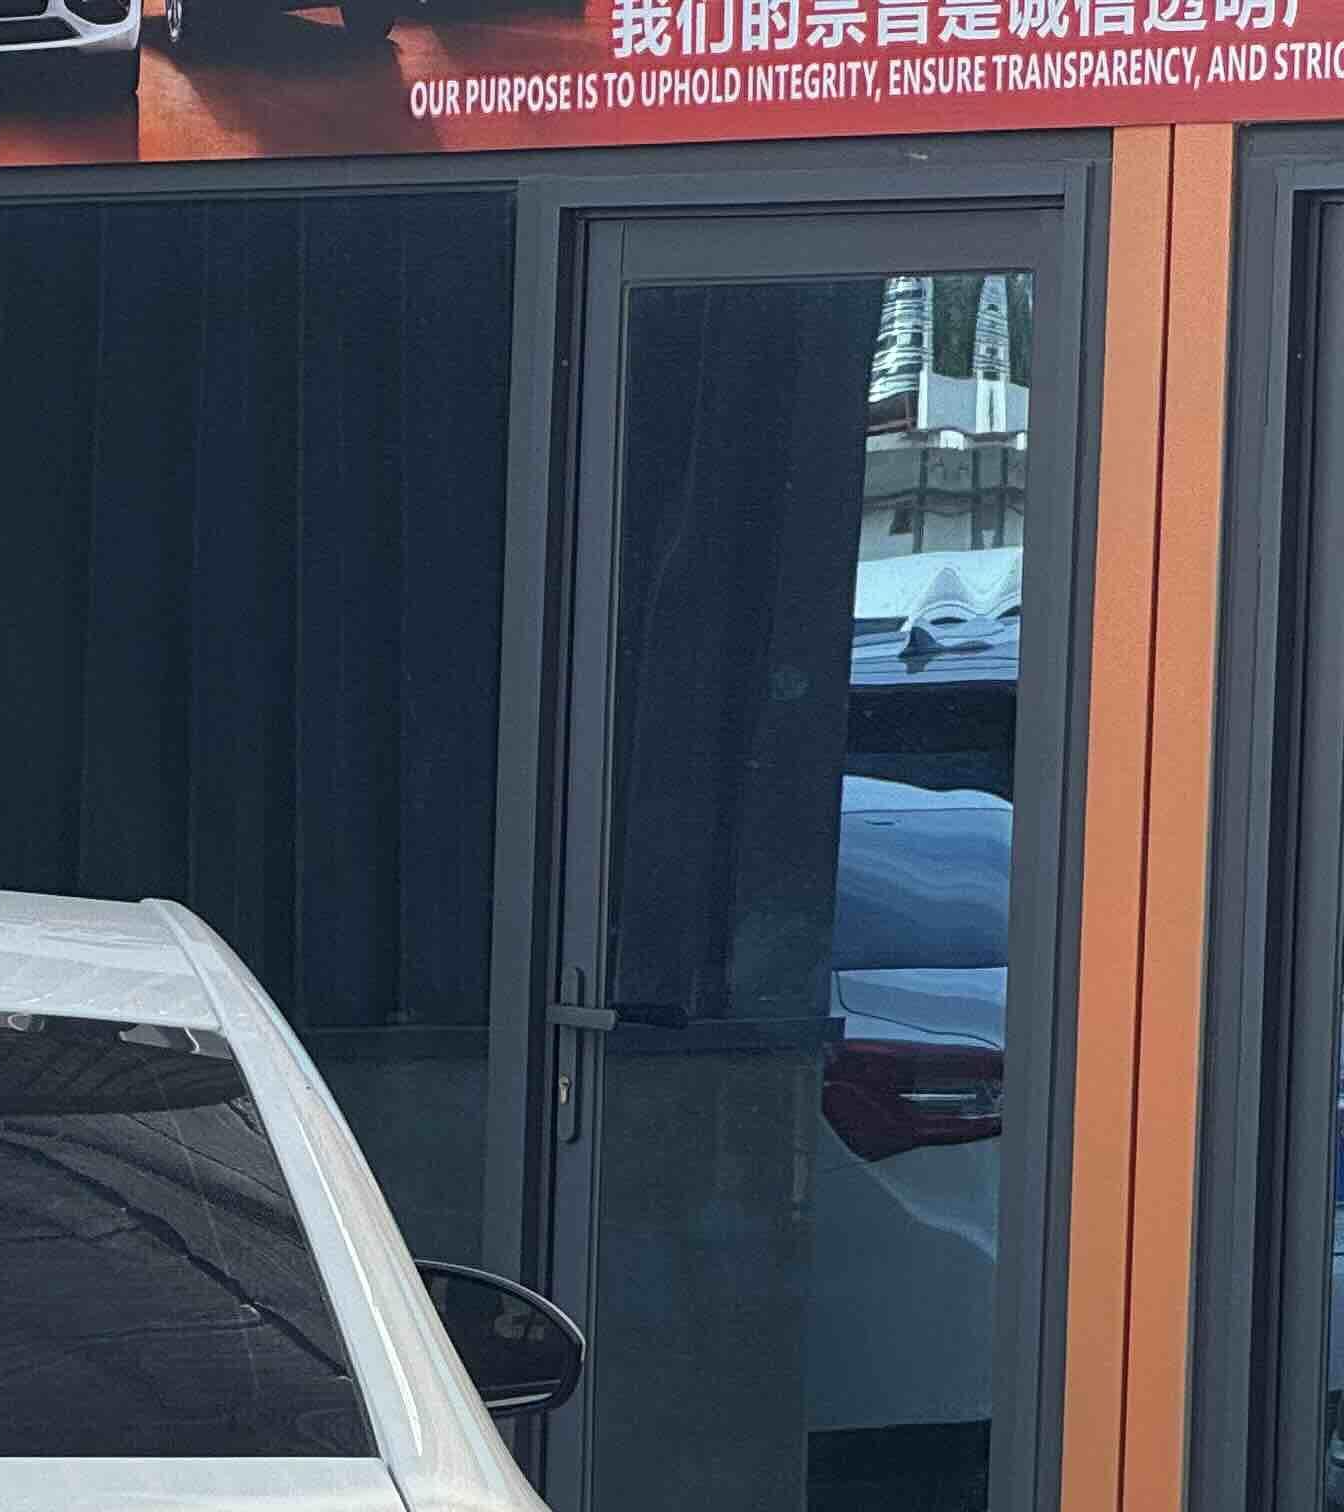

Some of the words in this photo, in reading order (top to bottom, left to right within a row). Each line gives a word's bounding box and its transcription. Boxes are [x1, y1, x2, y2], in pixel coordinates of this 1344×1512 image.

[410, 80, 460, 118] OUR
[466, 74, 571, 115] PURPOSE
[577, 73, 598, 109] IS
[603, 71, 634, 108] TO
[641, 67, 741, 107] UPHOLD
[748, 60, 881, 103] INTEGRITY,
[889, 56, 986, 96] ENSURE
[992, 47, 1202, 90] TRANSPARENCY,
[1207, 45, 1267, 82] AND
